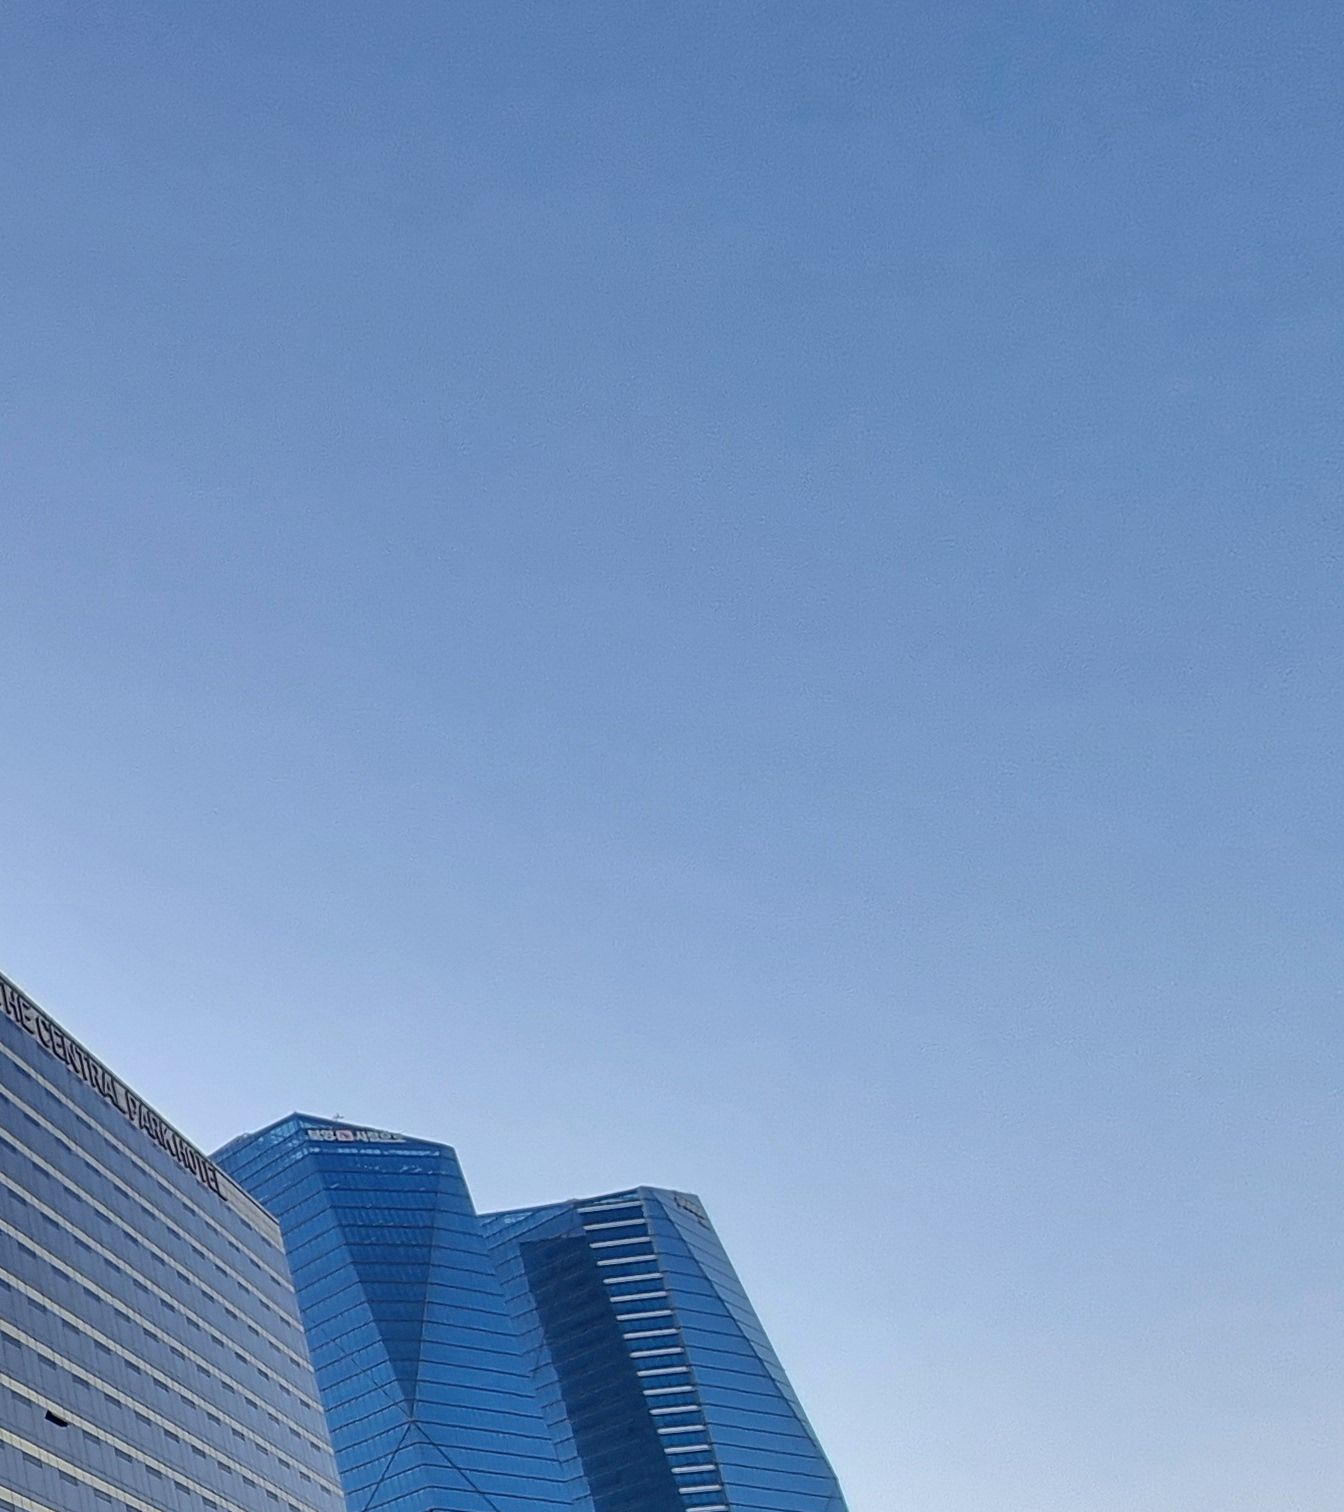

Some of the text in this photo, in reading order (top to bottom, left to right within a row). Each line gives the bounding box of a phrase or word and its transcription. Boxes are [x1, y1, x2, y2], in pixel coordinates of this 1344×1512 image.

[36, 1014, 127, 1115] CENTRAL
[125, 1089, 176, 1157] PARK
[173, 1134, 228, 1201] HOTEL
